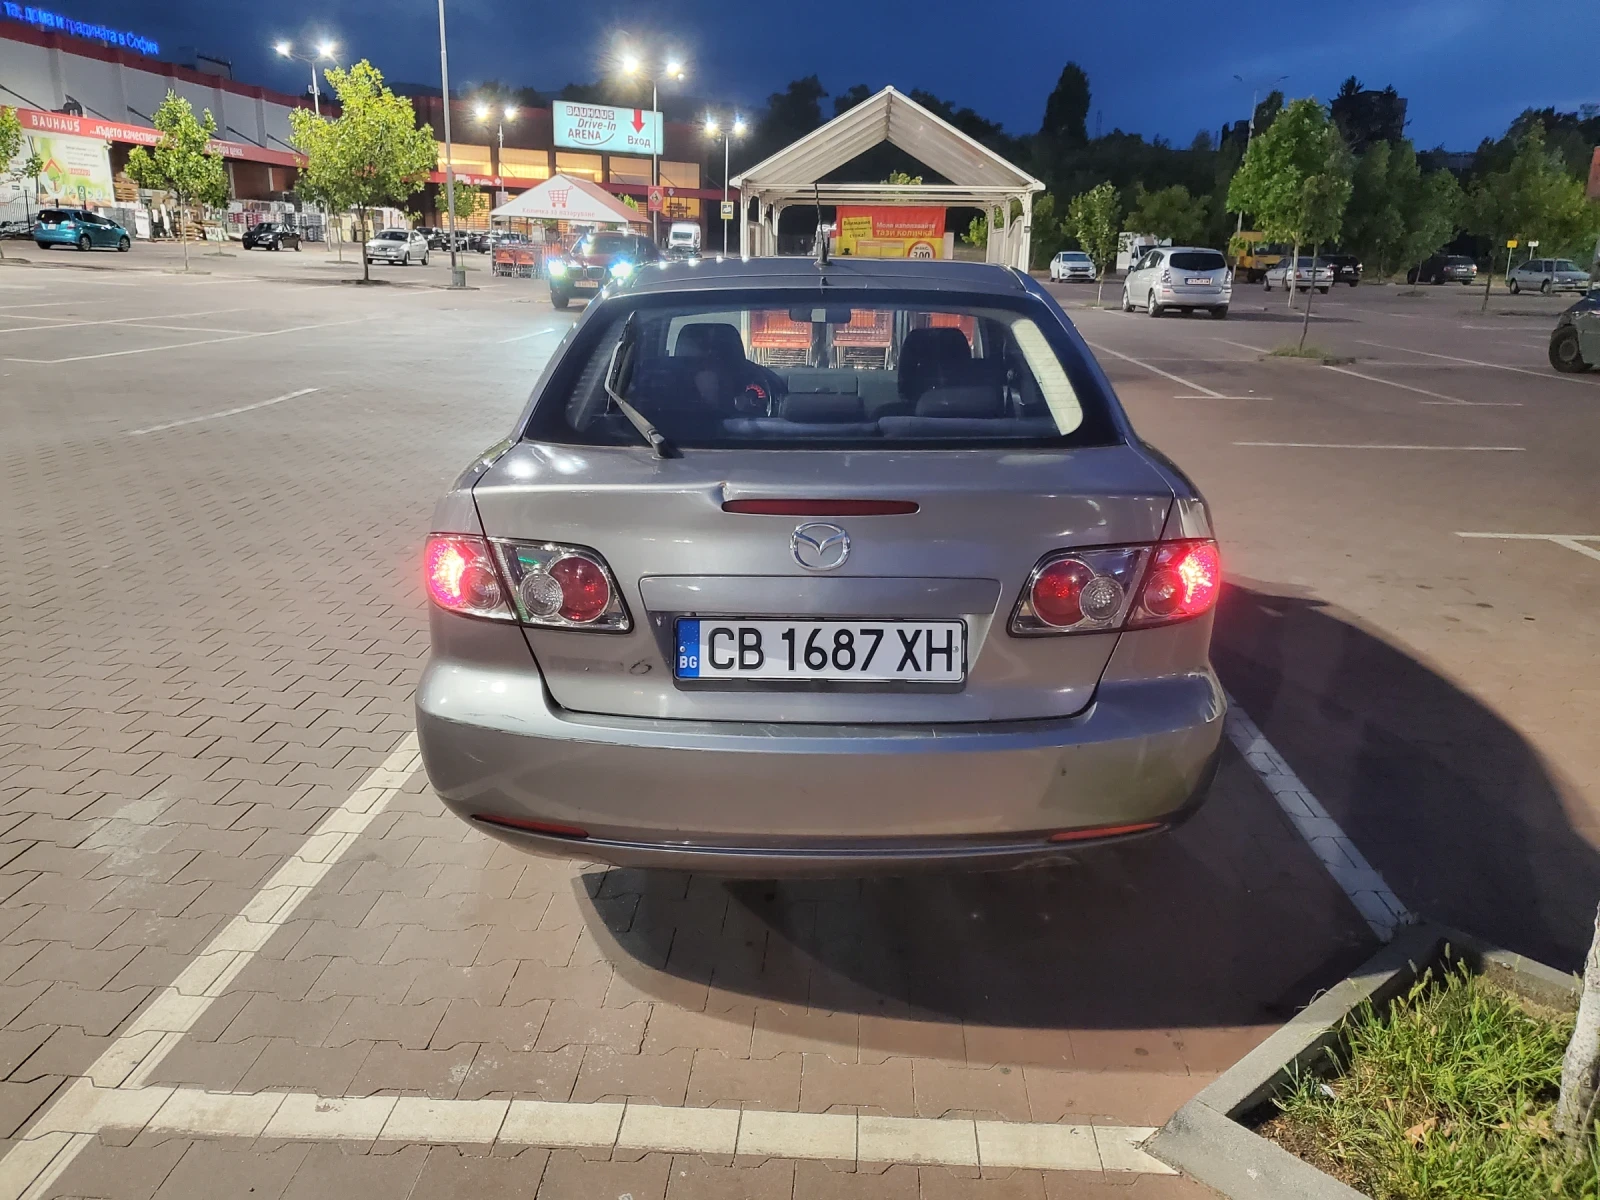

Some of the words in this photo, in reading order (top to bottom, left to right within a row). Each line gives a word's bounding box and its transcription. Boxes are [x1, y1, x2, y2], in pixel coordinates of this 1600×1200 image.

[25, 6, 54, 27] дома
[55, 14, 64, 30] и
[65, 18, 117, 42] градината
[118, 32, 126, 46] в
[127, 31, 160, 55] София
[566, 105, 615, 121] BAUHAUS
[31, 114, 81, 132] BAUHAUS
[577, 118, 617, 131] Drive-In
[568, 128, 602, 141] ARENA
[627, 135, 651, 148] Вход
[876, 229, 895, 237] тази
[707, 627, 765, 671] CB
[781, 628, 884, 672] 1687
[895, 629, 953, 672] XH
[679, 655, 698, 669] BG
